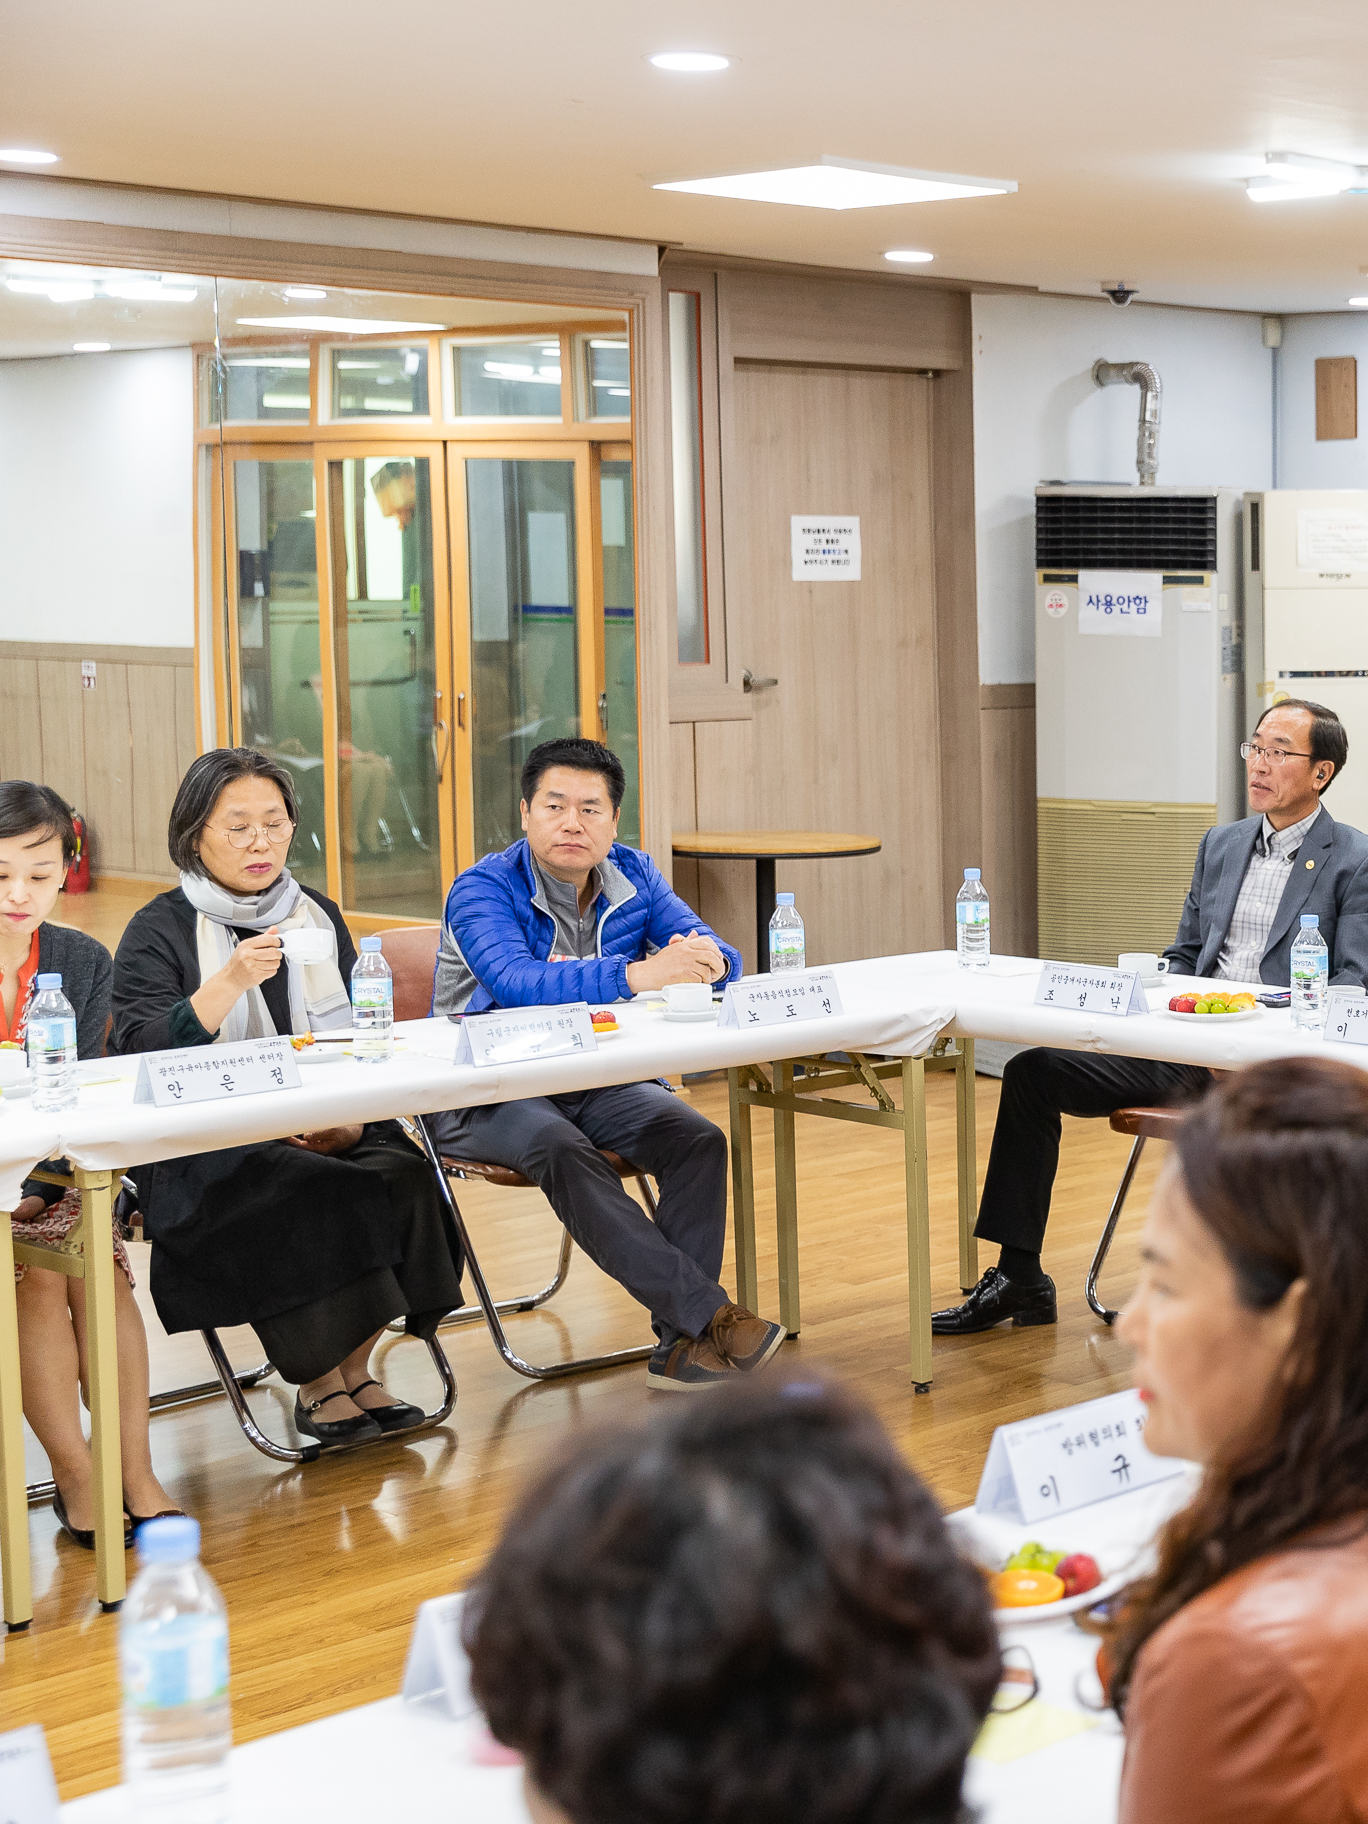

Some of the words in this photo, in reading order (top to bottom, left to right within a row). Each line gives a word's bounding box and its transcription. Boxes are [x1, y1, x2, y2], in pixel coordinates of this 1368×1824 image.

[1086, 594, 1149, 615] 사용안함
[809, 985, 824, 994] 대표
[1109, 981, 1123, 992] 회장
[487, 1021, 553, 1038] 구립군자어린이집
[557, 1018, 574, 1030] 원장
[158, 1054, 254, 1077] 광진구육아종합지원센터
[259, 1051, 284, 1065] 센터장
[1061, 1420, 1127, 1456] 방위협의회
